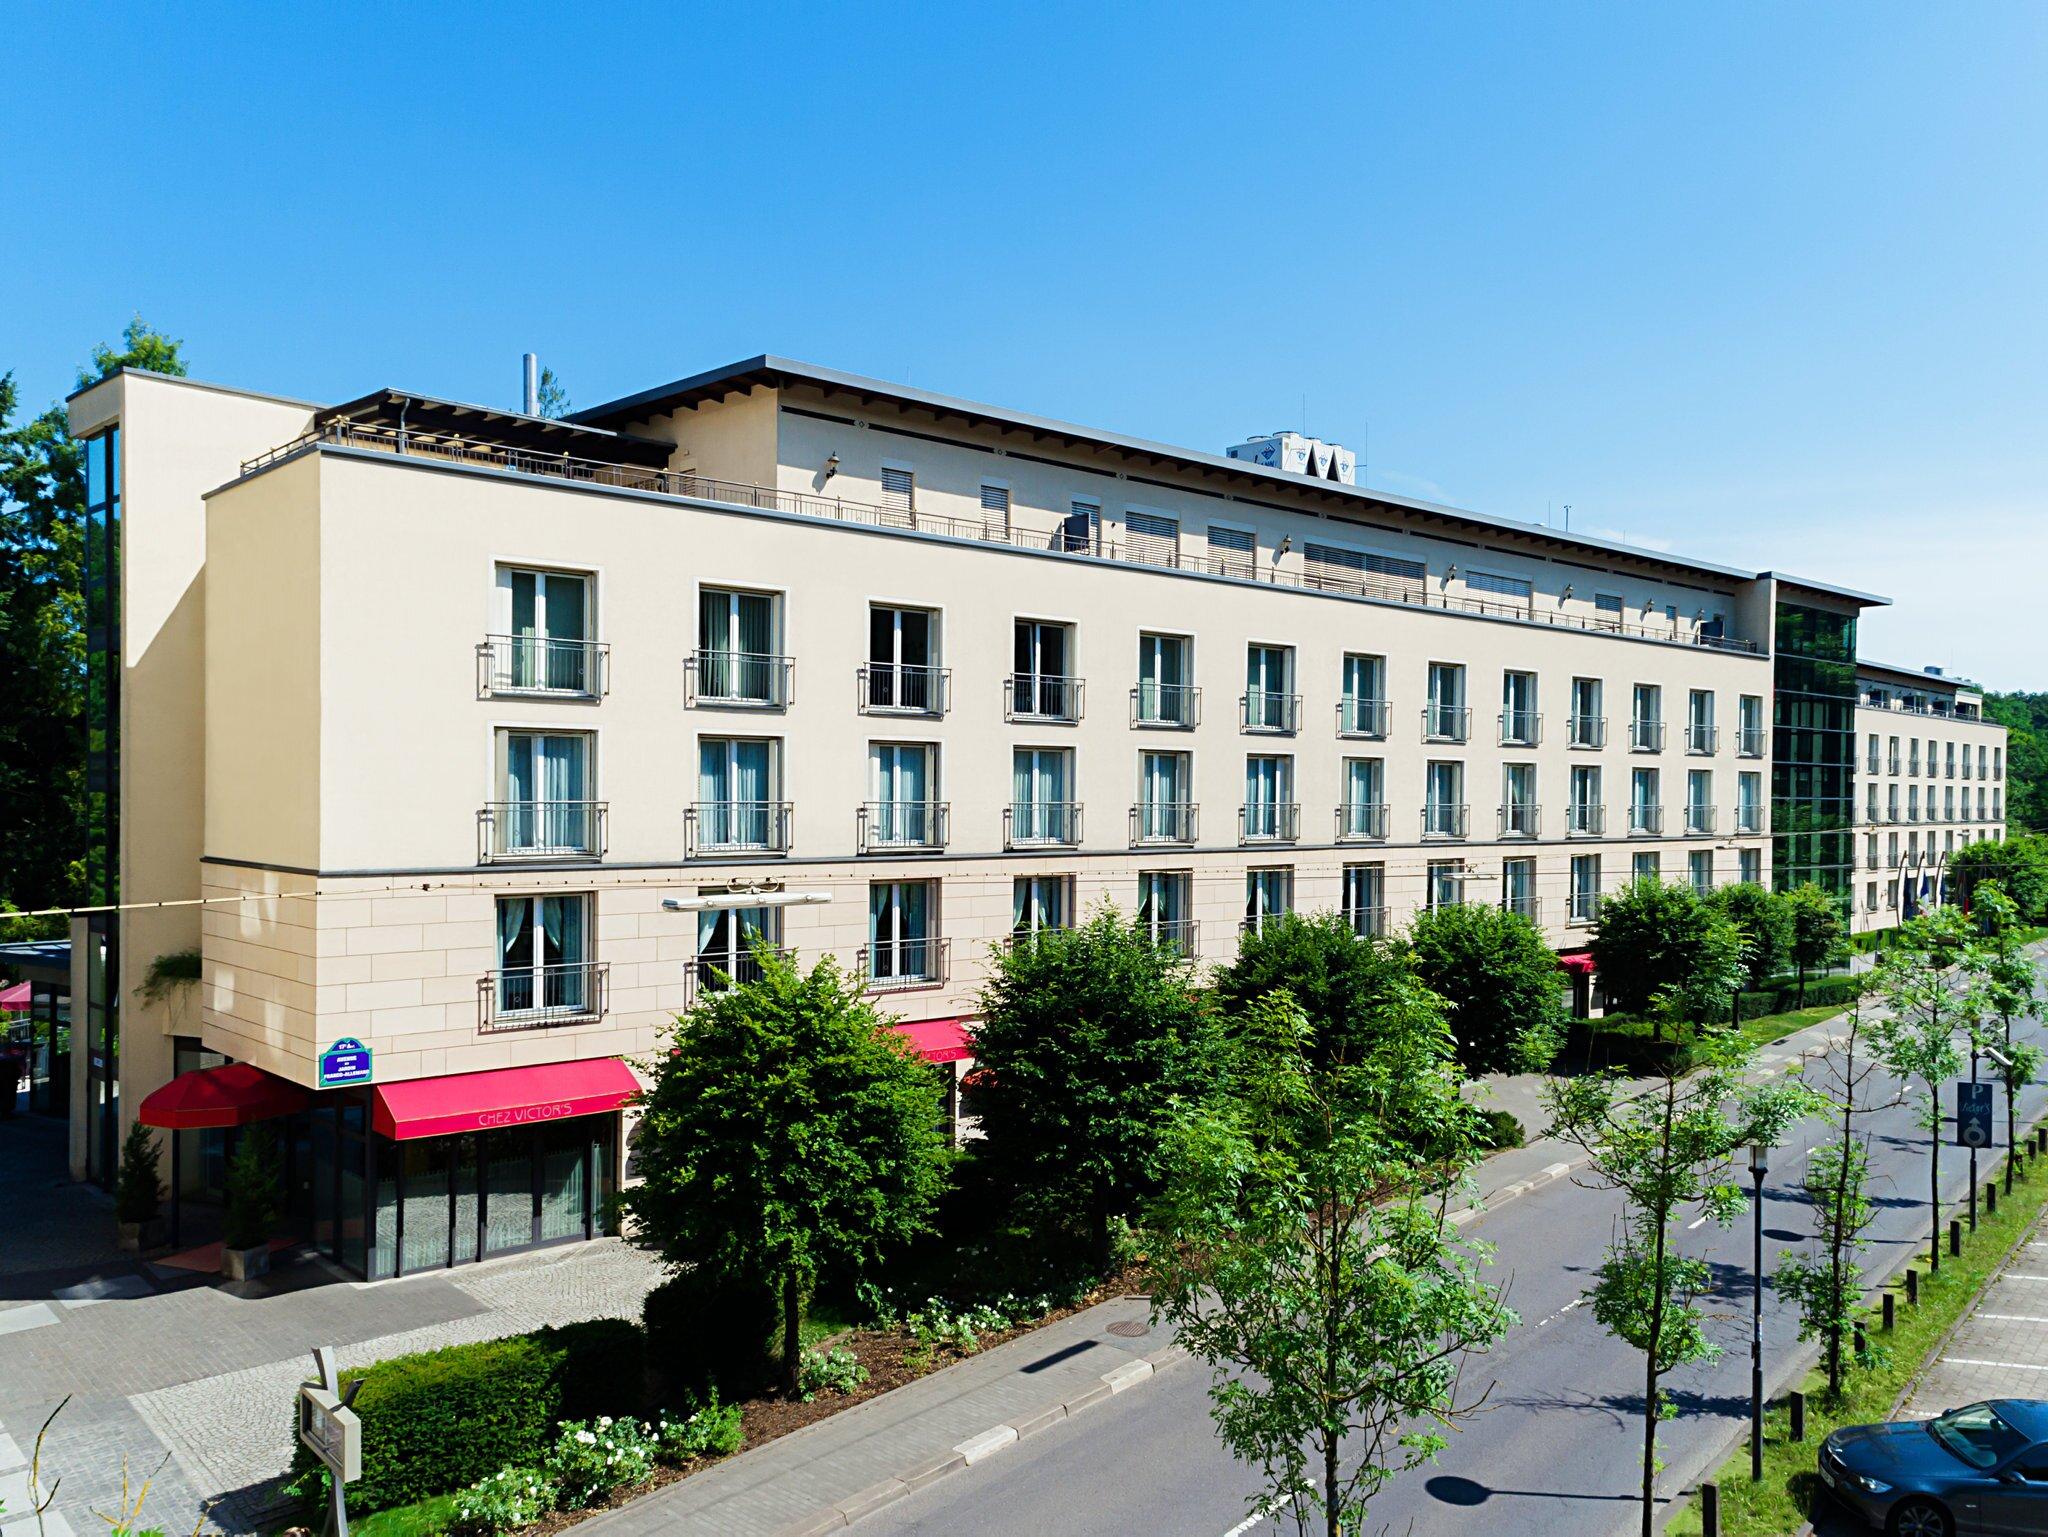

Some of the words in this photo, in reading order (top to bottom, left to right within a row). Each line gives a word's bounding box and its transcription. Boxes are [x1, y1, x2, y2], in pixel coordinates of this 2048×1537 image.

[1972, 1085, 1983, 1099] P
[478, 1111, 512, 1126] CHEZ
[514, 1103, 573, 1121] VICTOR'S
